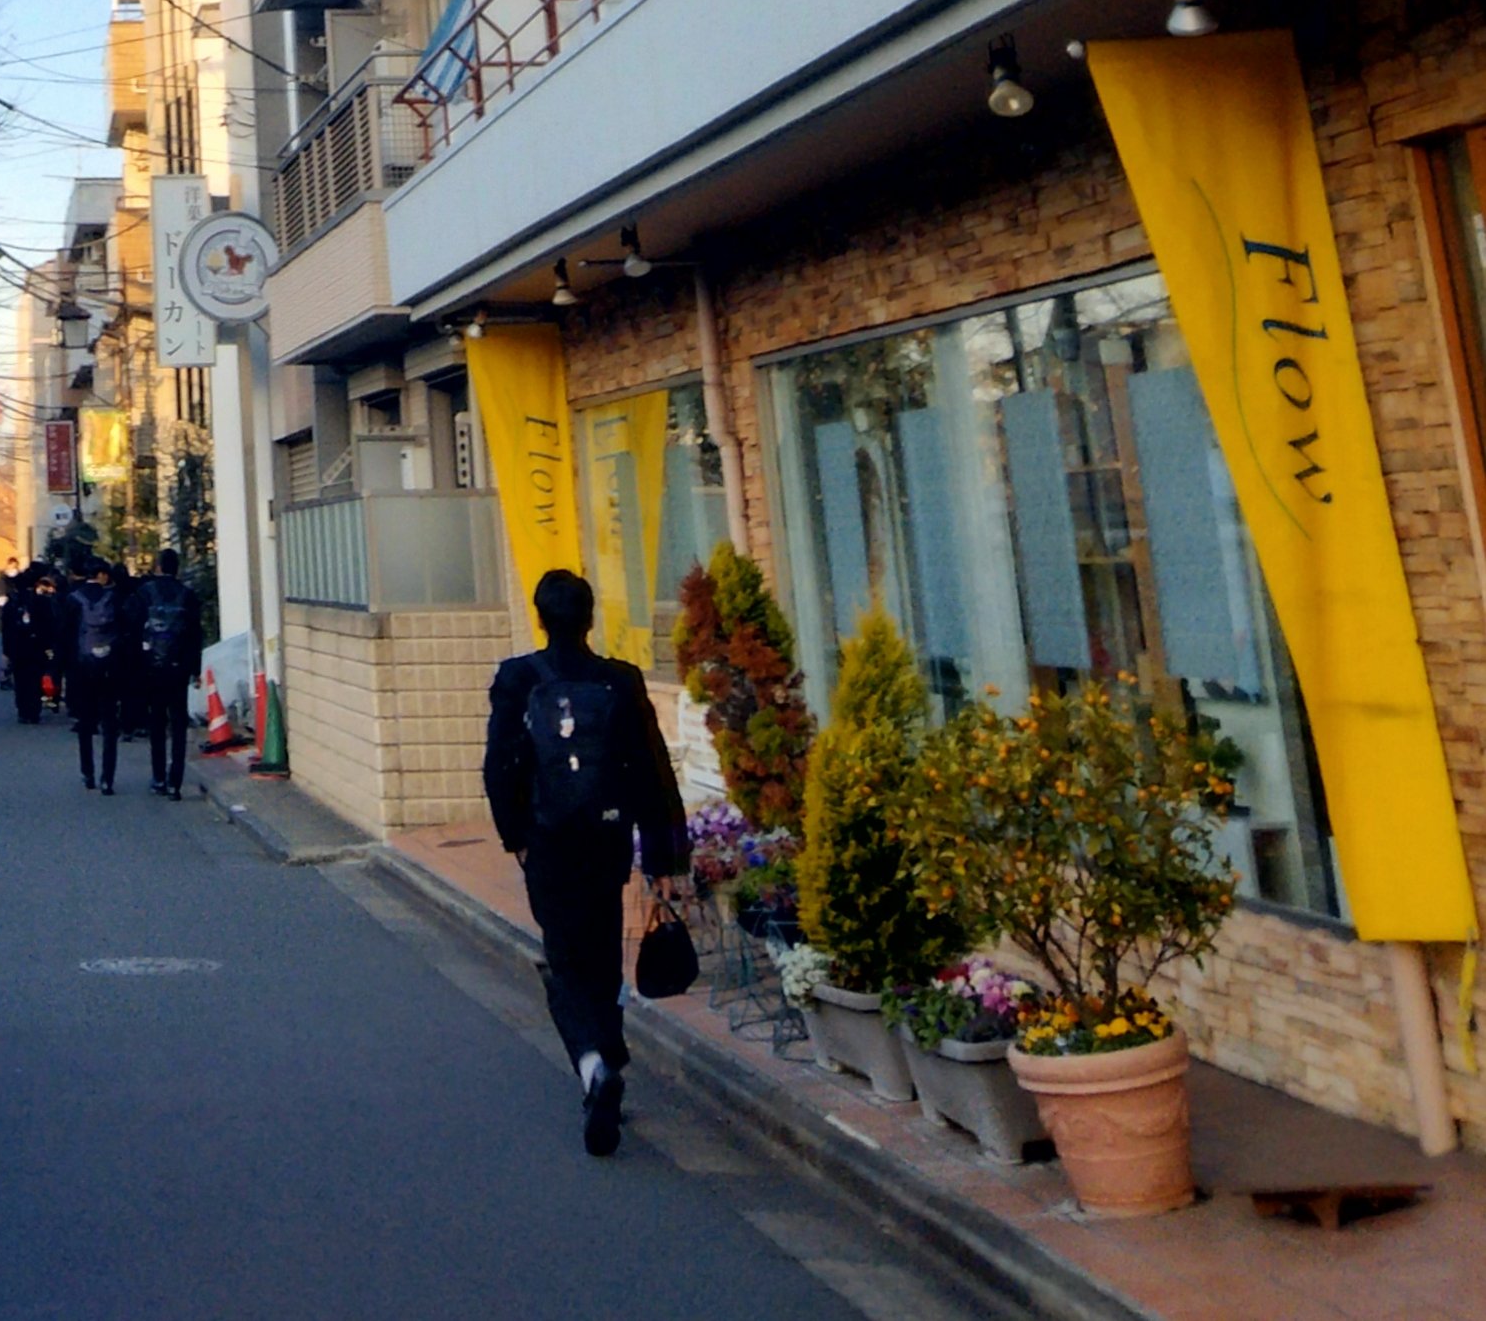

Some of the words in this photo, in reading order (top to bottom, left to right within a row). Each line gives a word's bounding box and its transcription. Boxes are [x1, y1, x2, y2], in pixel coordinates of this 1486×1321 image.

[164, 230, 185, 357] ドーカン
[1241, 231, 1332, 504] Flow
[525, 415, 562, 536] Flow
